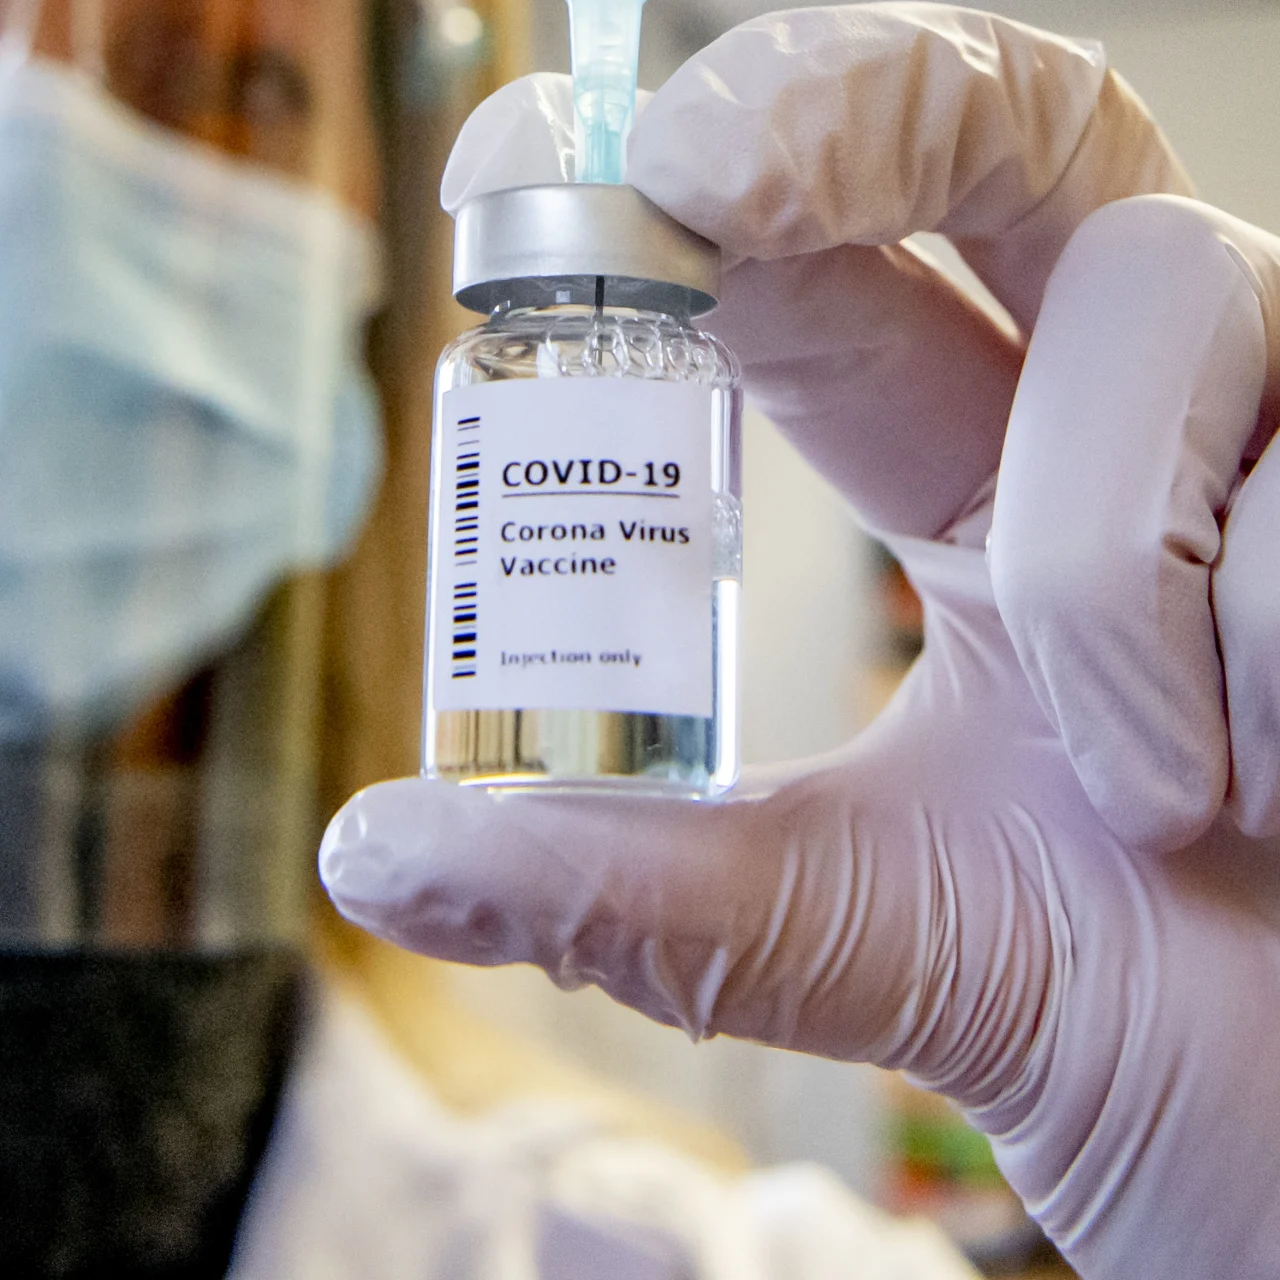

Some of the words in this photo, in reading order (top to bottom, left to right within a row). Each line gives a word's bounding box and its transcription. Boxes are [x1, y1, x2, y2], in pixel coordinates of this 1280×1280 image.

[502, 459, 681, 488] COVID-19
[501, 521, 605, 542] Corona
[619, 518, 690, 544] Virus
[500, 552, 616, 576] Vaccine
[500, 649, 592, 669] Injection
[599, 648, 641, 668] only
